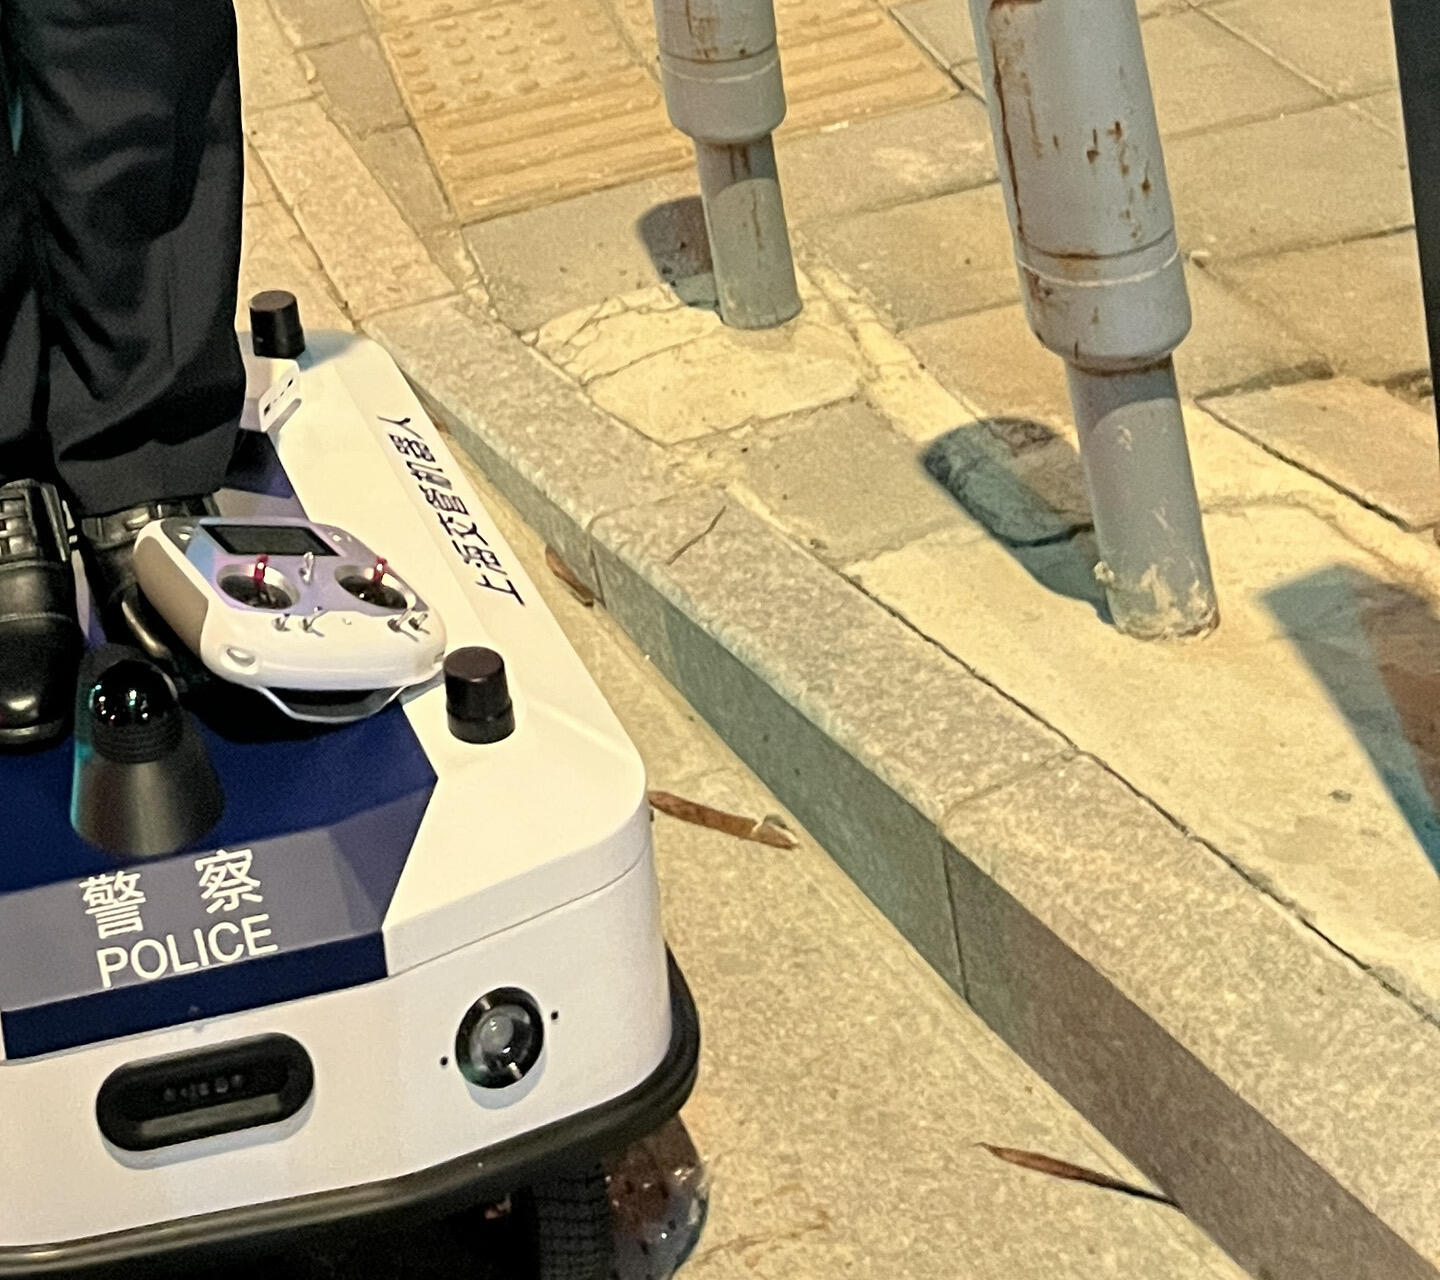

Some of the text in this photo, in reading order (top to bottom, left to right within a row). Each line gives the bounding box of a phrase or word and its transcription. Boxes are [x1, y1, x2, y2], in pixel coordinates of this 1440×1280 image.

[377, 415, 525, 607] 上海交管机器人
[78, 848, 264, 940] 警察
[96, 913, 278, 989] POLICE
